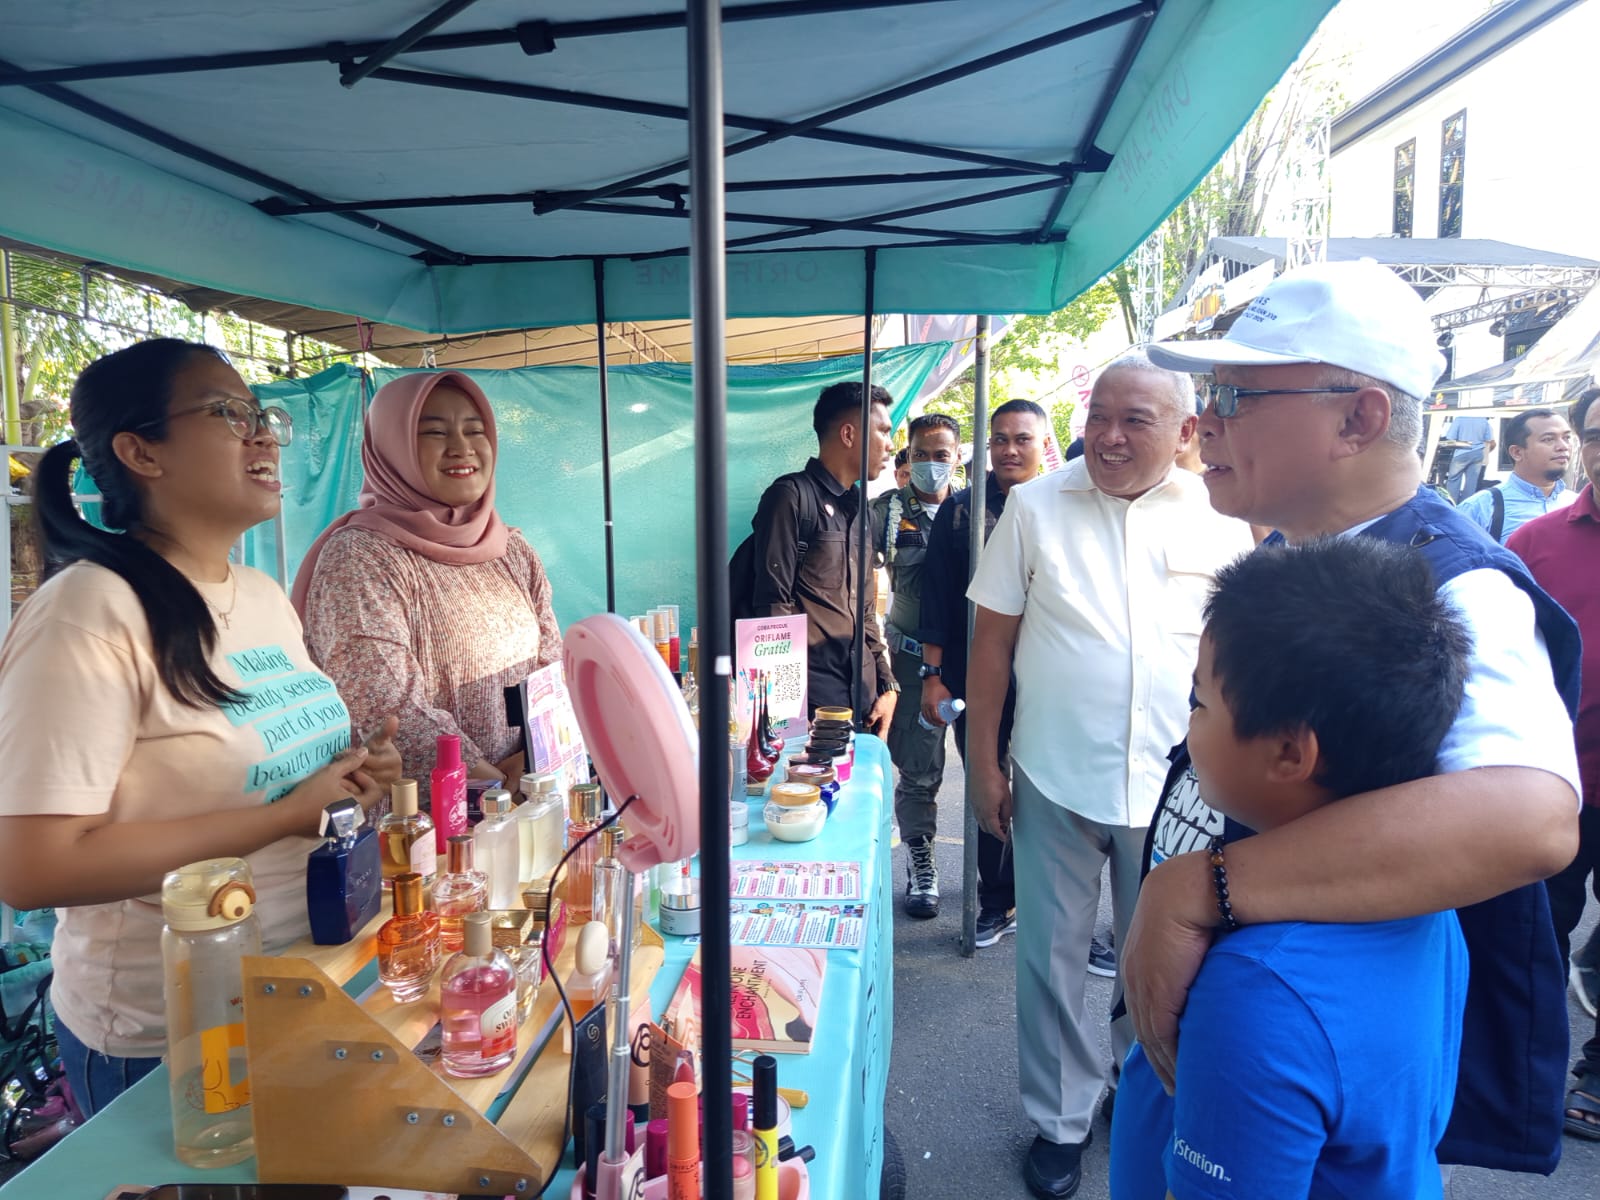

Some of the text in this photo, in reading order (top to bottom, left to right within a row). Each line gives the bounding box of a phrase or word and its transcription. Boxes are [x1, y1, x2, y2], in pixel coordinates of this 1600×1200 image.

[754, 632, 792, 642] ORIFLAME
[754, 641, 791, 657] Gratis!
[232, 649, 295, 676] Making
[230, 686, 286, 717] beauty
[263, 701, 347, 751] part of your
[252, 754, 311, 787] beauty
[735, 960, 768, 1019] ENCHANTMENT
[1173, 1136, 1225, 1181] yStation
